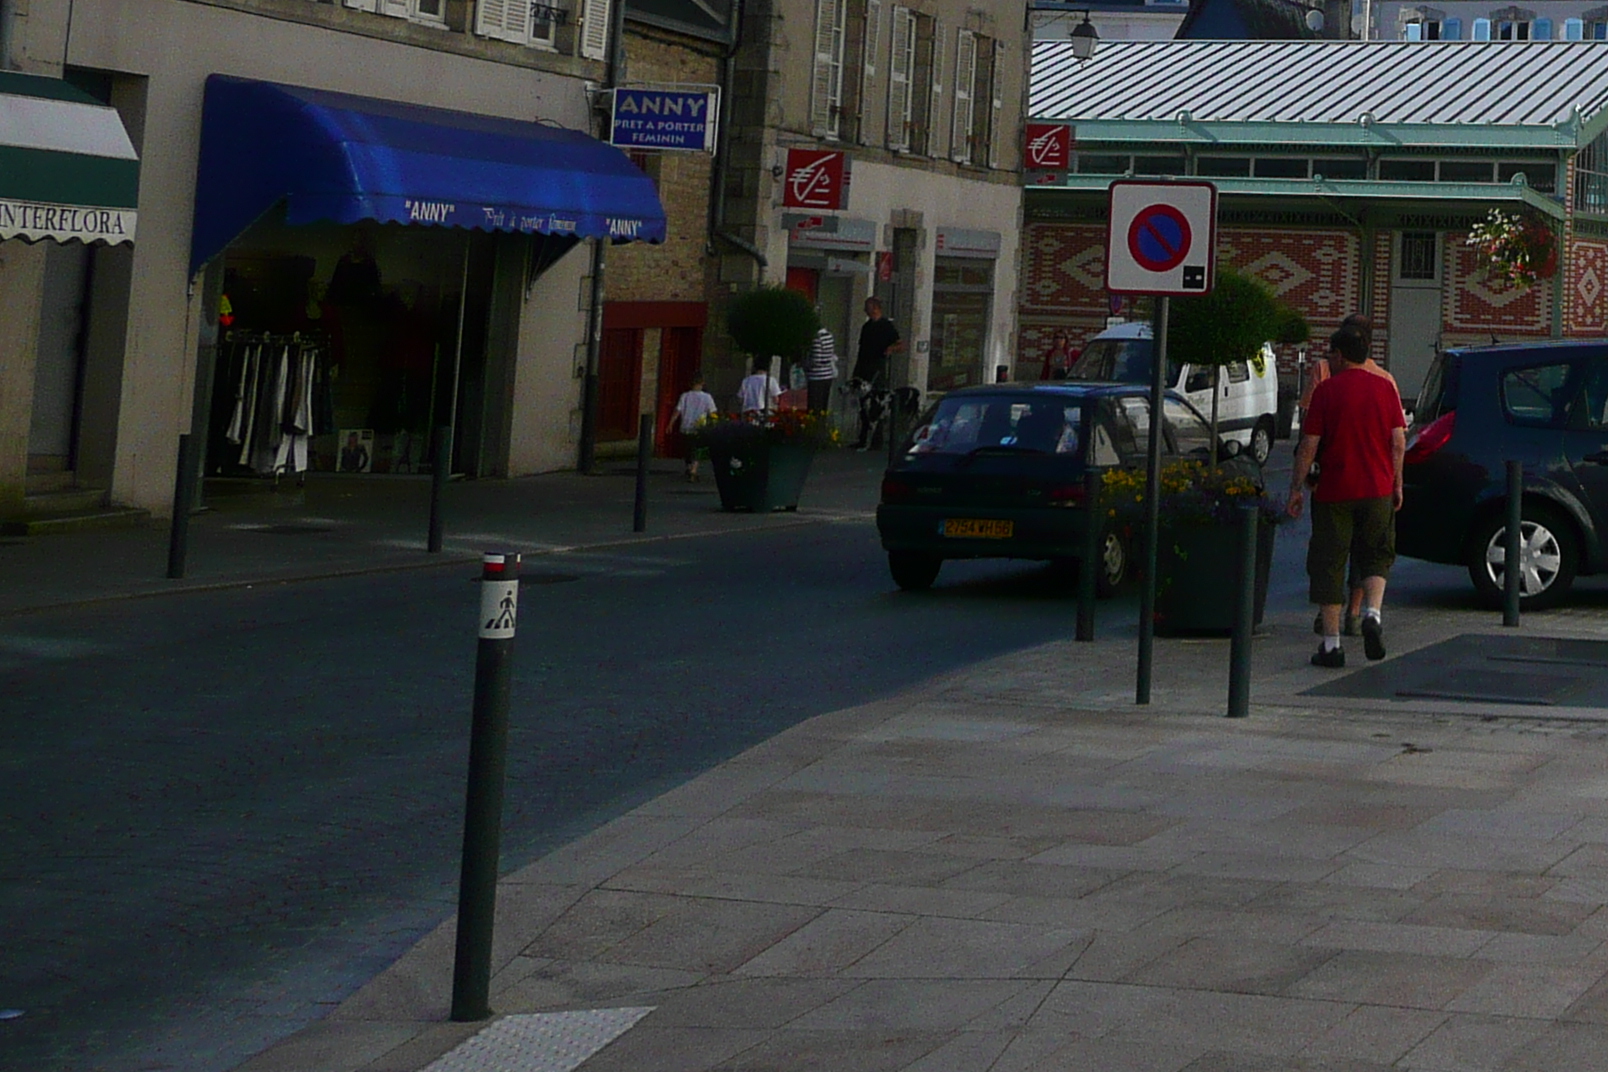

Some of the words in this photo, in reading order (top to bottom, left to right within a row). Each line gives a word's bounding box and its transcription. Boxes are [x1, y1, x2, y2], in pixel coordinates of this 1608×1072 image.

[619, 95, 705, 117] ANNY
[615, 119, 644, 129] PRET
[646, 121, 654, 129] A
[658, 121, 704, 133] PORTER
[632, 133, 685, 144] FEMININ
